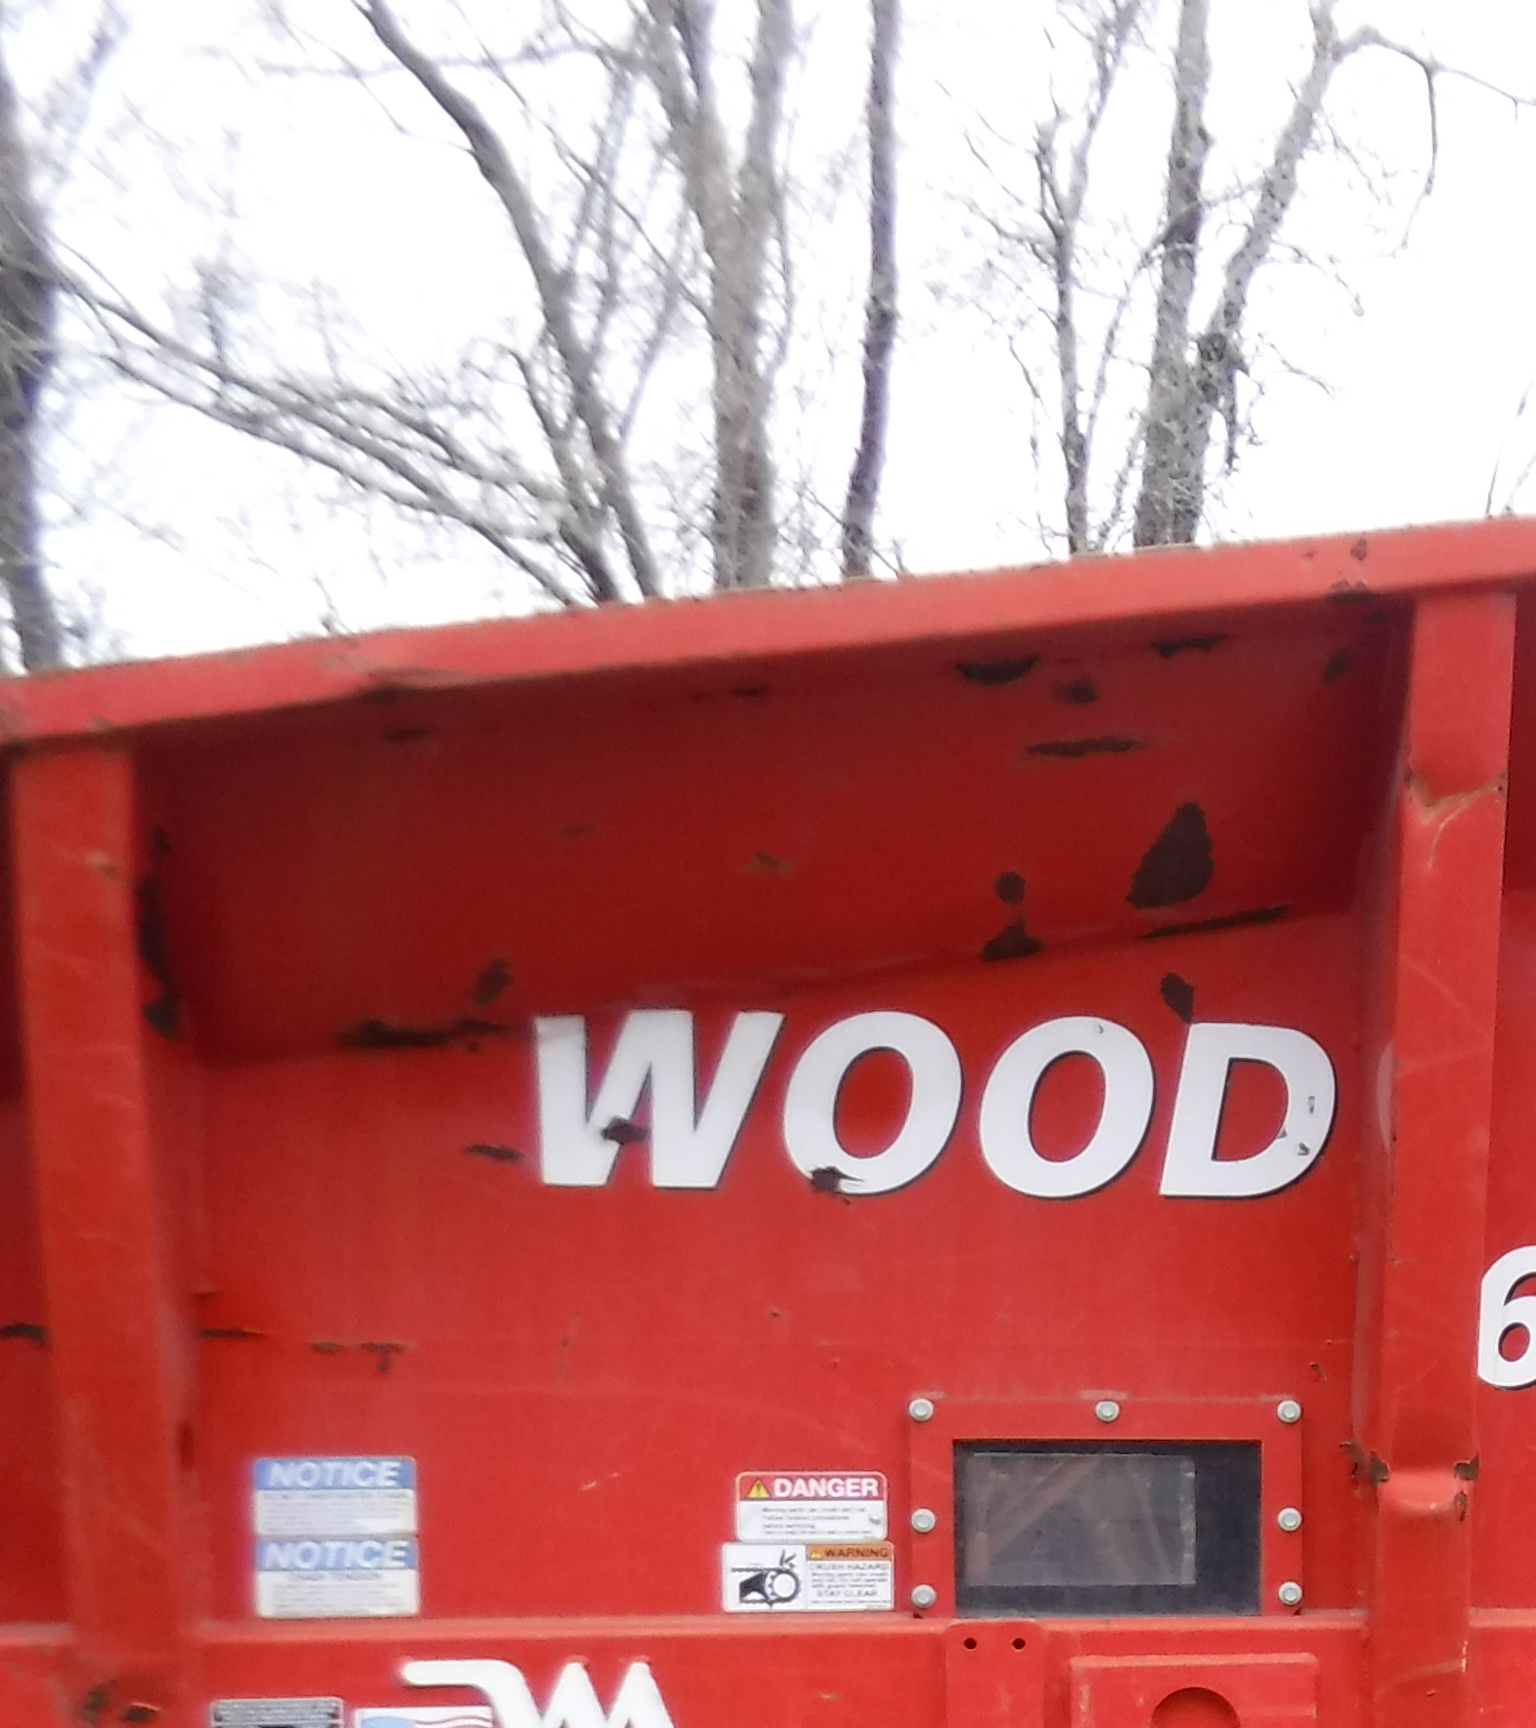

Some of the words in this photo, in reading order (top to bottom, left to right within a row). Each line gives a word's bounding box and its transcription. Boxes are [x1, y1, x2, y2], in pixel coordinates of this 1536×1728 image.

[534, 1009, 1337, 1199] WOOD
[269, 1461, 402, 1487] NOTICE
[774, 1478, 879, 1498] DANGER
[265, 1540, 409, 1569] NOTICE
[824, 1547, 889, 1557] WARNING
